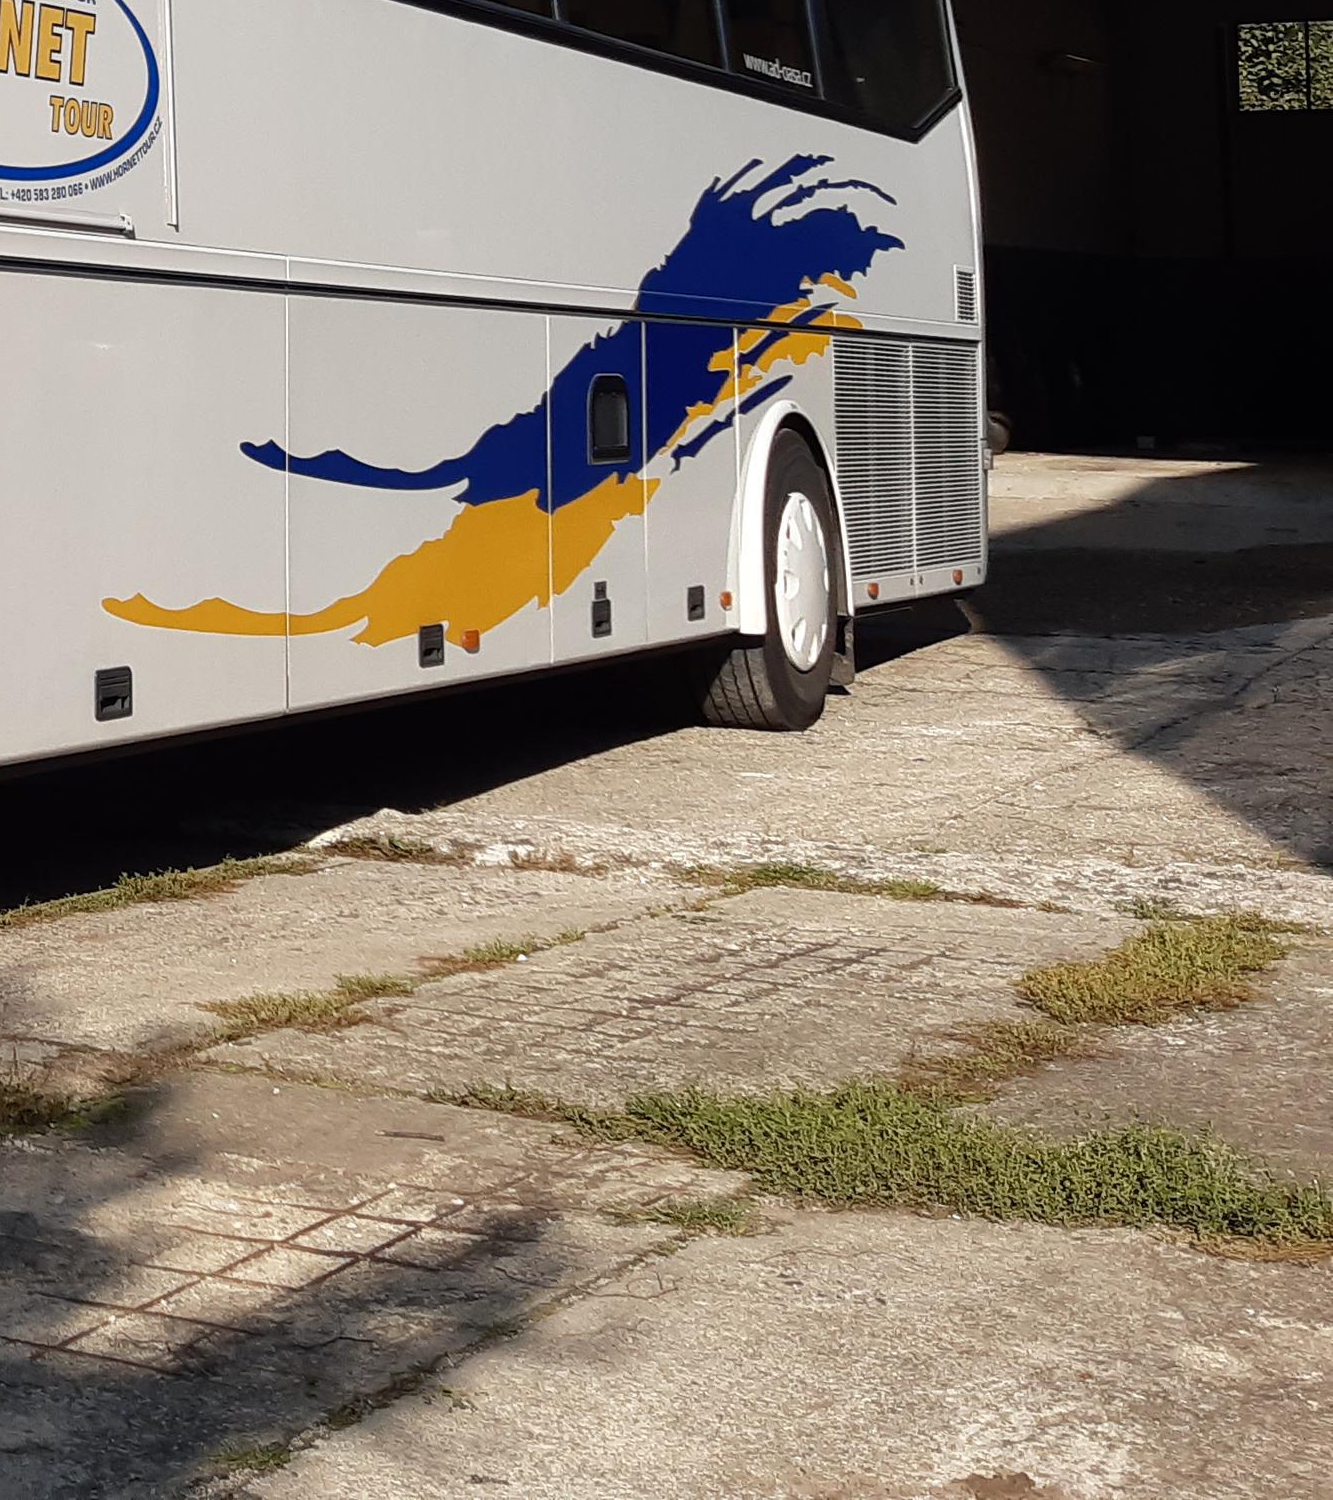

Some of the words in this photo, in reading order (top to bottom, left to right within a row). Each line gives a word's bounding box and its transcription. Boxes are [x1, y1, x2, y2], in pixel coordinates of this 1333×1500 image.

[49, 95, 113, 141] TOUR
[11, 188, 32, 201] +420
[33, 187, 49, 200] 583
[51, 185, 66, 199] 280
[68, 182, 83, 197] 066
